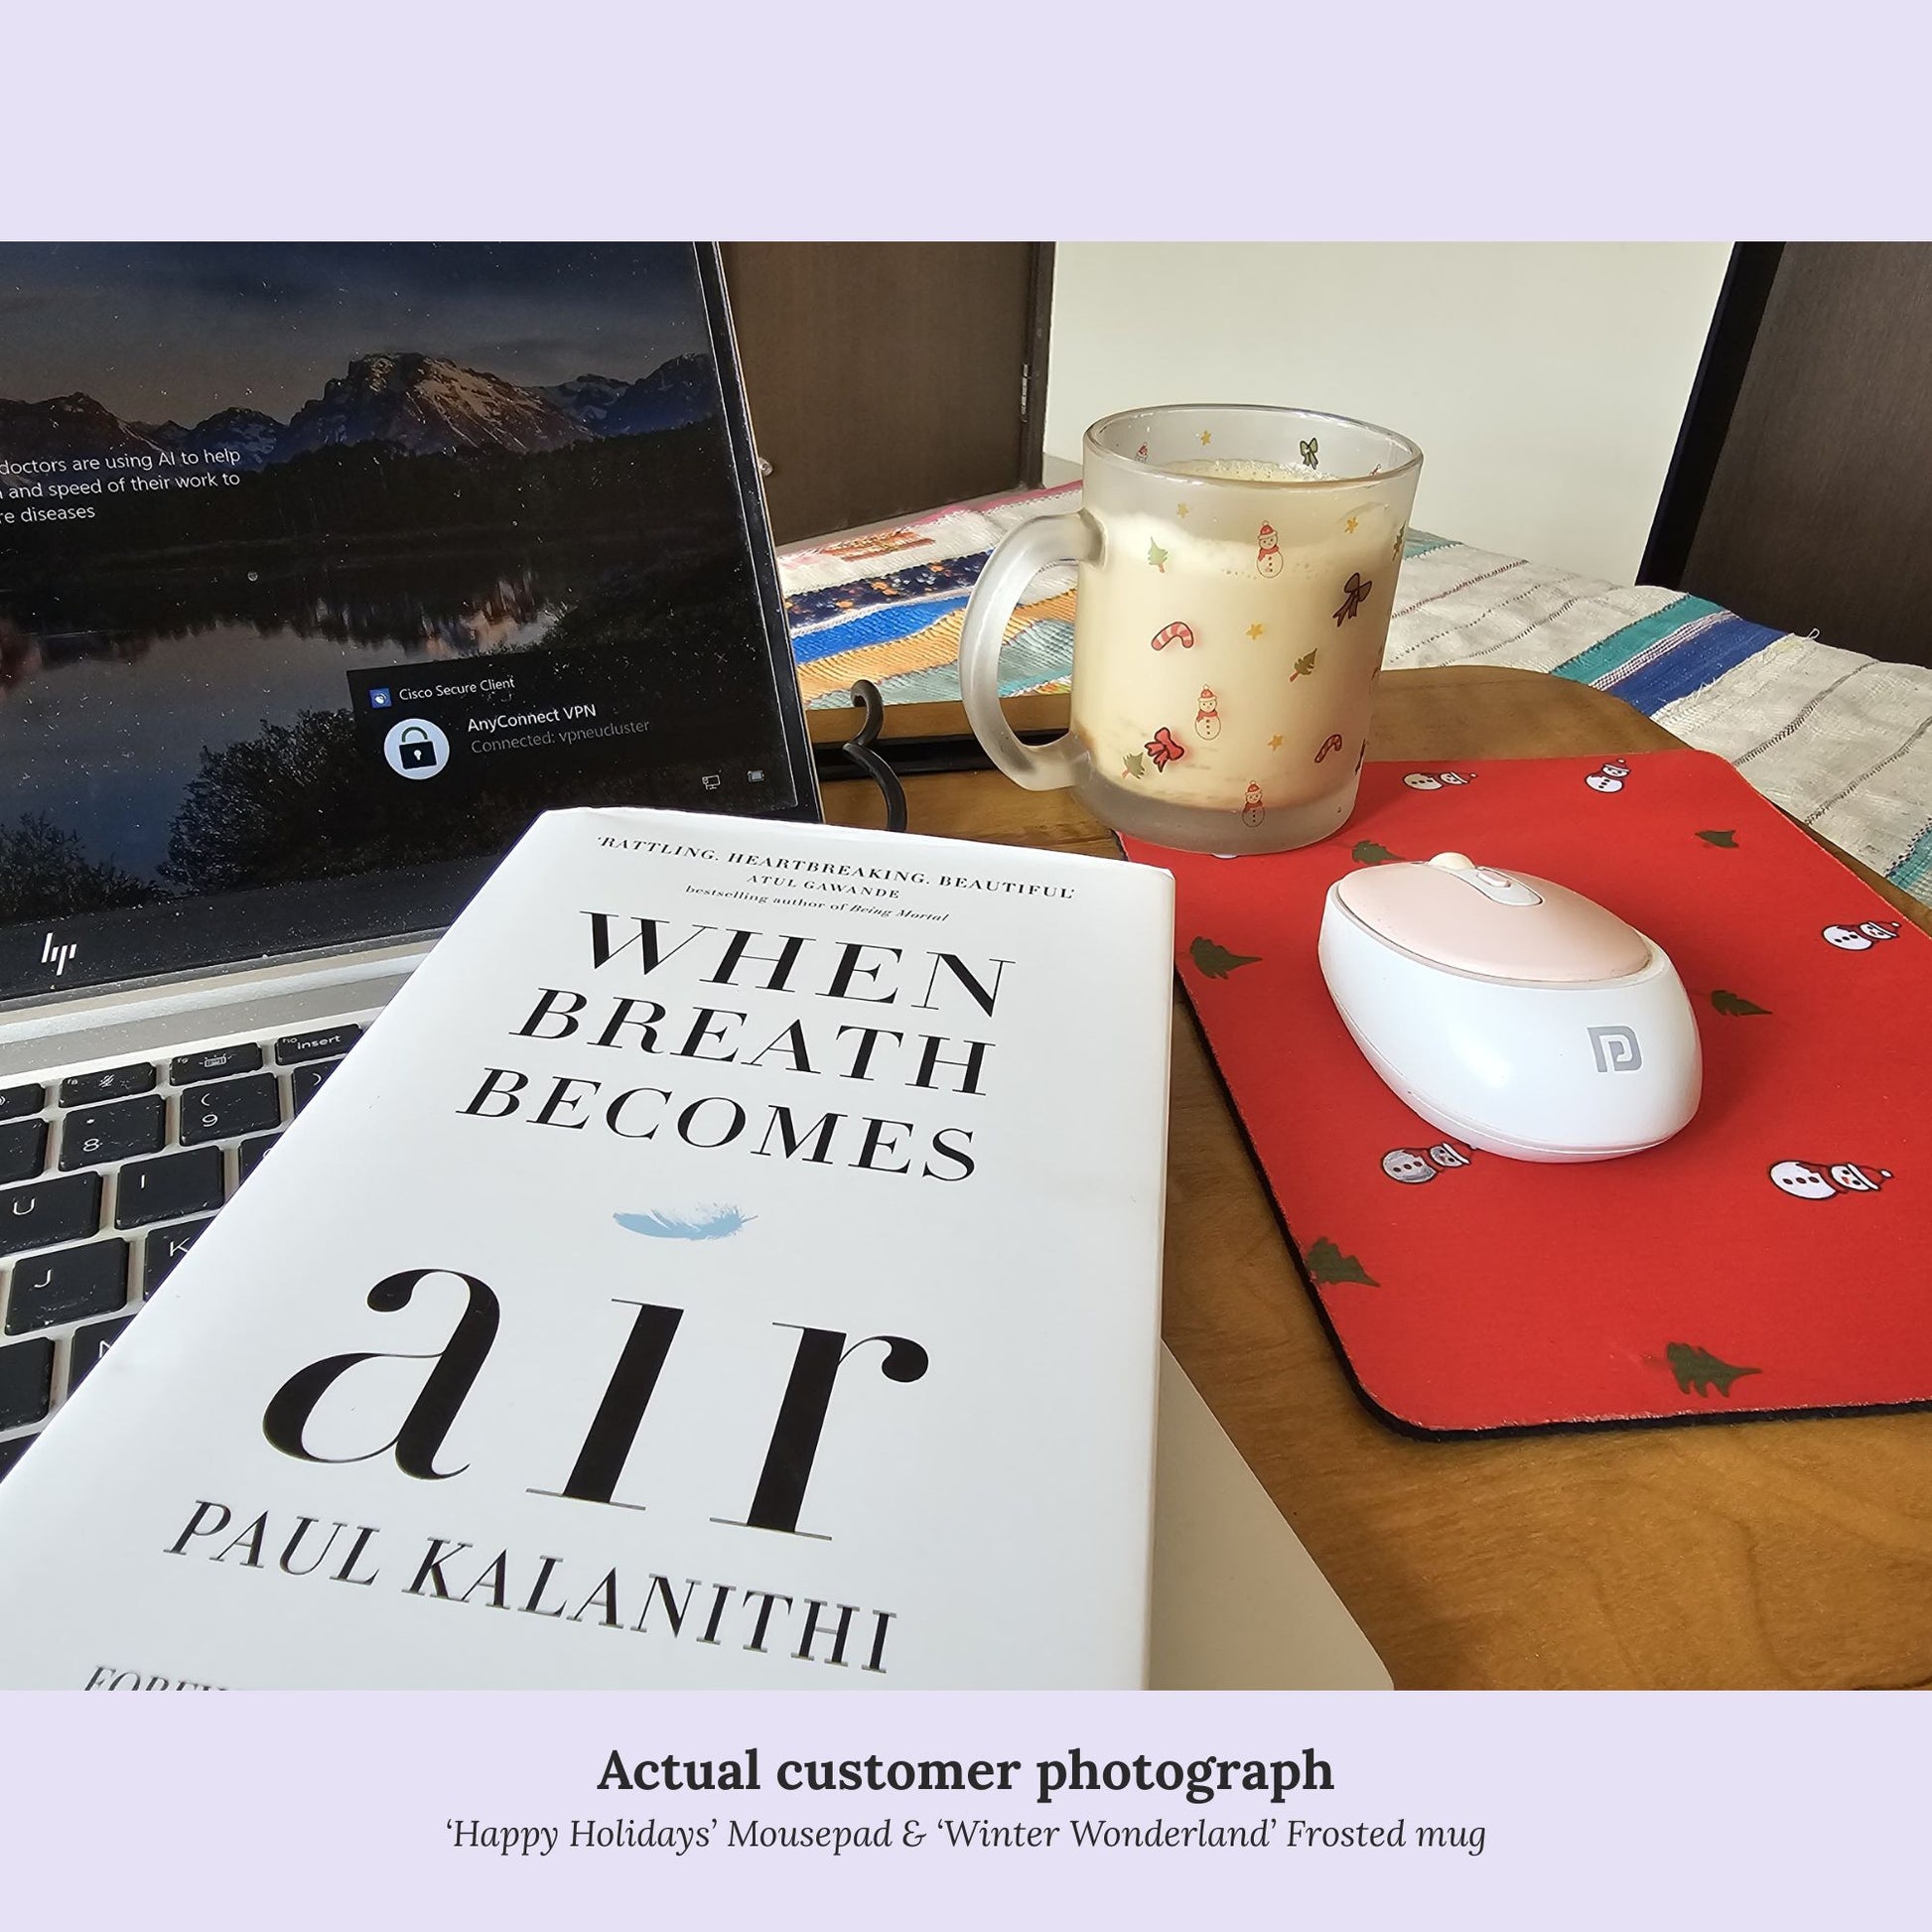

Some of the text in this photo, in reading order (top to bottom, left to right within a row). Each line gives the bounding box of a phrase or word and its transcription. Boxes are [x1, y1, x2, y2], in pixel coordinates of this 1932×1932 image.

[0, 448, 241, 476] doctors are using AI to help
[8, 482, 44, 499] and
[49, 479, 102, 499] speed
[107, 477, 126, 492] of
[130, 475, 171, 491] their
[175, 473, 218, 488] work
[221, 473, 240, 486] to
[21, 506, 96, 523] diseases
[399, 676, 516, 701] Cisco Secure Client
[468, 703, 598, 734] AnyConnect VPN
[471, 720, 650, 754] Connected: vpneucluster
[728, 852, 931, 885] HEARTBREAKING.
[747, 875, 899, 898] ATUL GAWANDE
[686, 885, 950, 922] bestselling author of Being Mortal
[579, 910, 1017, 1019] WHEN
[507, 988, 997, 1096] BREATH
[202, 1113, 218, 1128] 9
[455, 1067, 976, 1181] BECOMES
[82, 1138, 100, 1153] 8
[12, 1197, 36, 1216] U
[34, 1269, 52, 1289] J
[162, 1499, 897, 1674] PAUL KALANITHI
